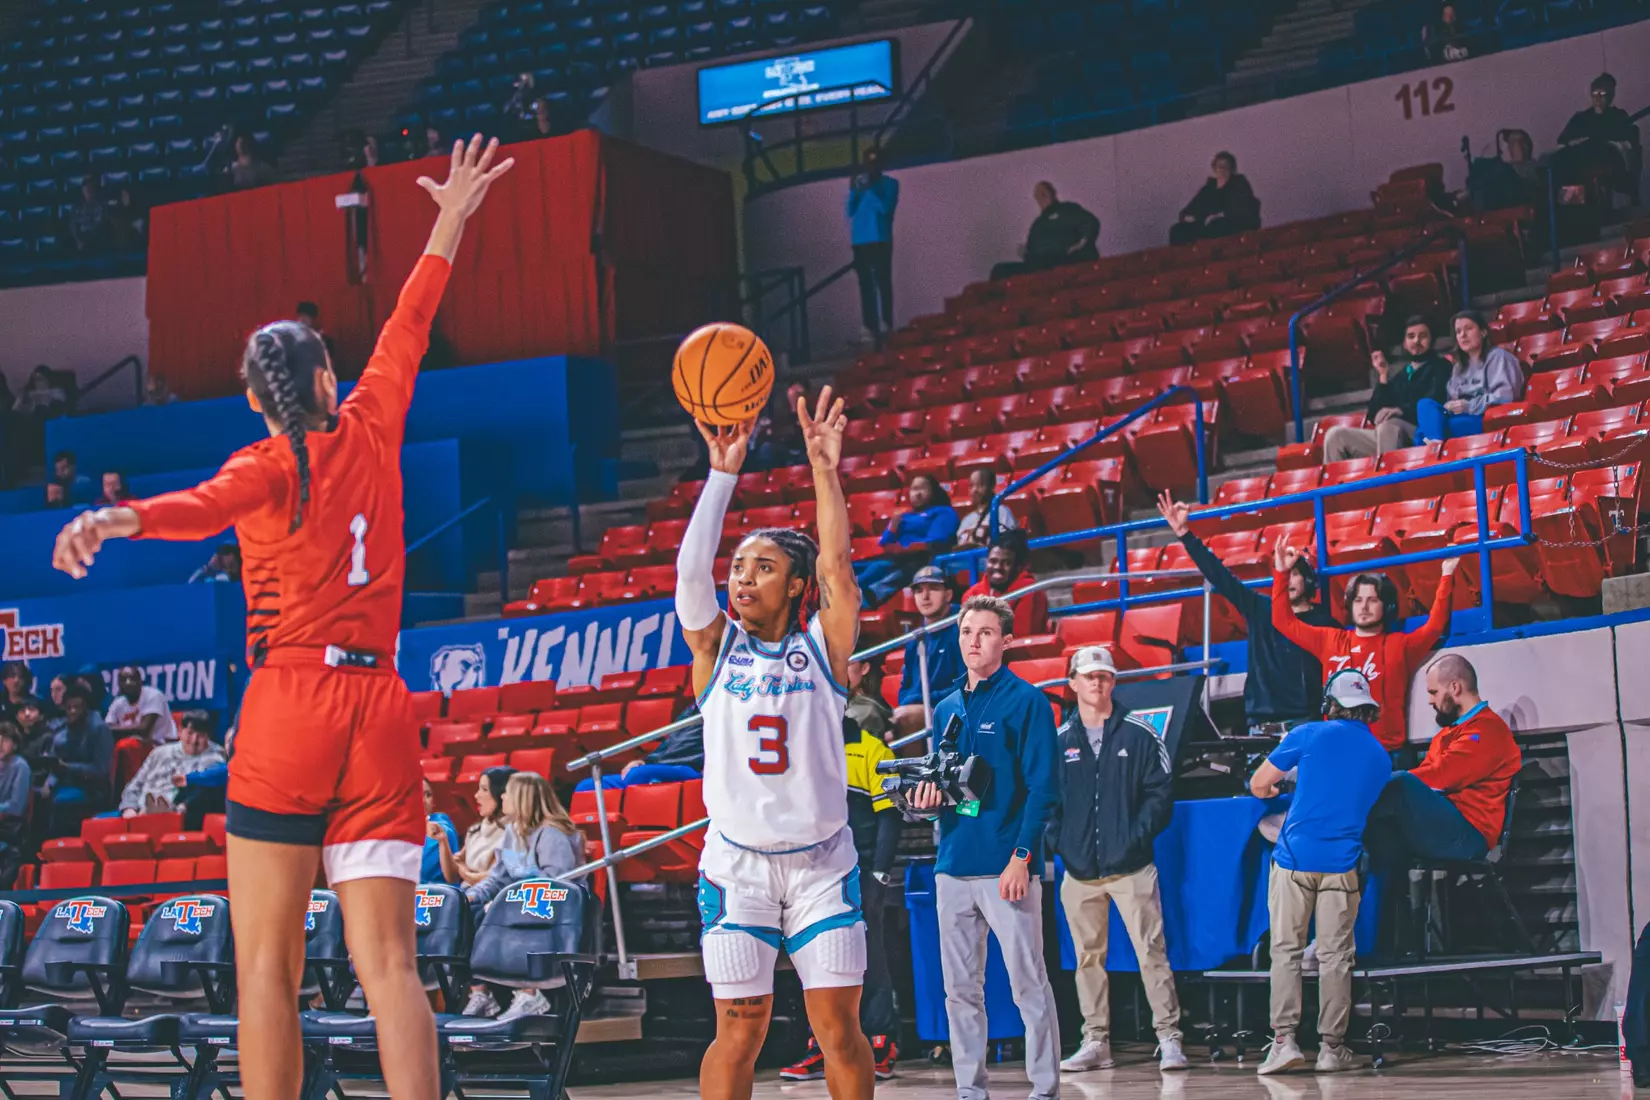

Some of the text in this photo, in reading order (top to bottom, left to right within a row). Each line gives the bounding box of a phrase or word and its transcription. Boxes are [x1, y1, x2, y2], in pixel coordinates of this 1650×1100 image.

[1395, 76, 1455, 120] 112
[347, 511, 369, 586] 1
[0, 608, 64, 660] ECH
[101, 659, 216, 701] TION
[724, 670, 756, 702] Lady
[1326, 652, 1381, 681] Th
[748, 715, 789, 775] 3
[506, 890, 525, 901] LA
